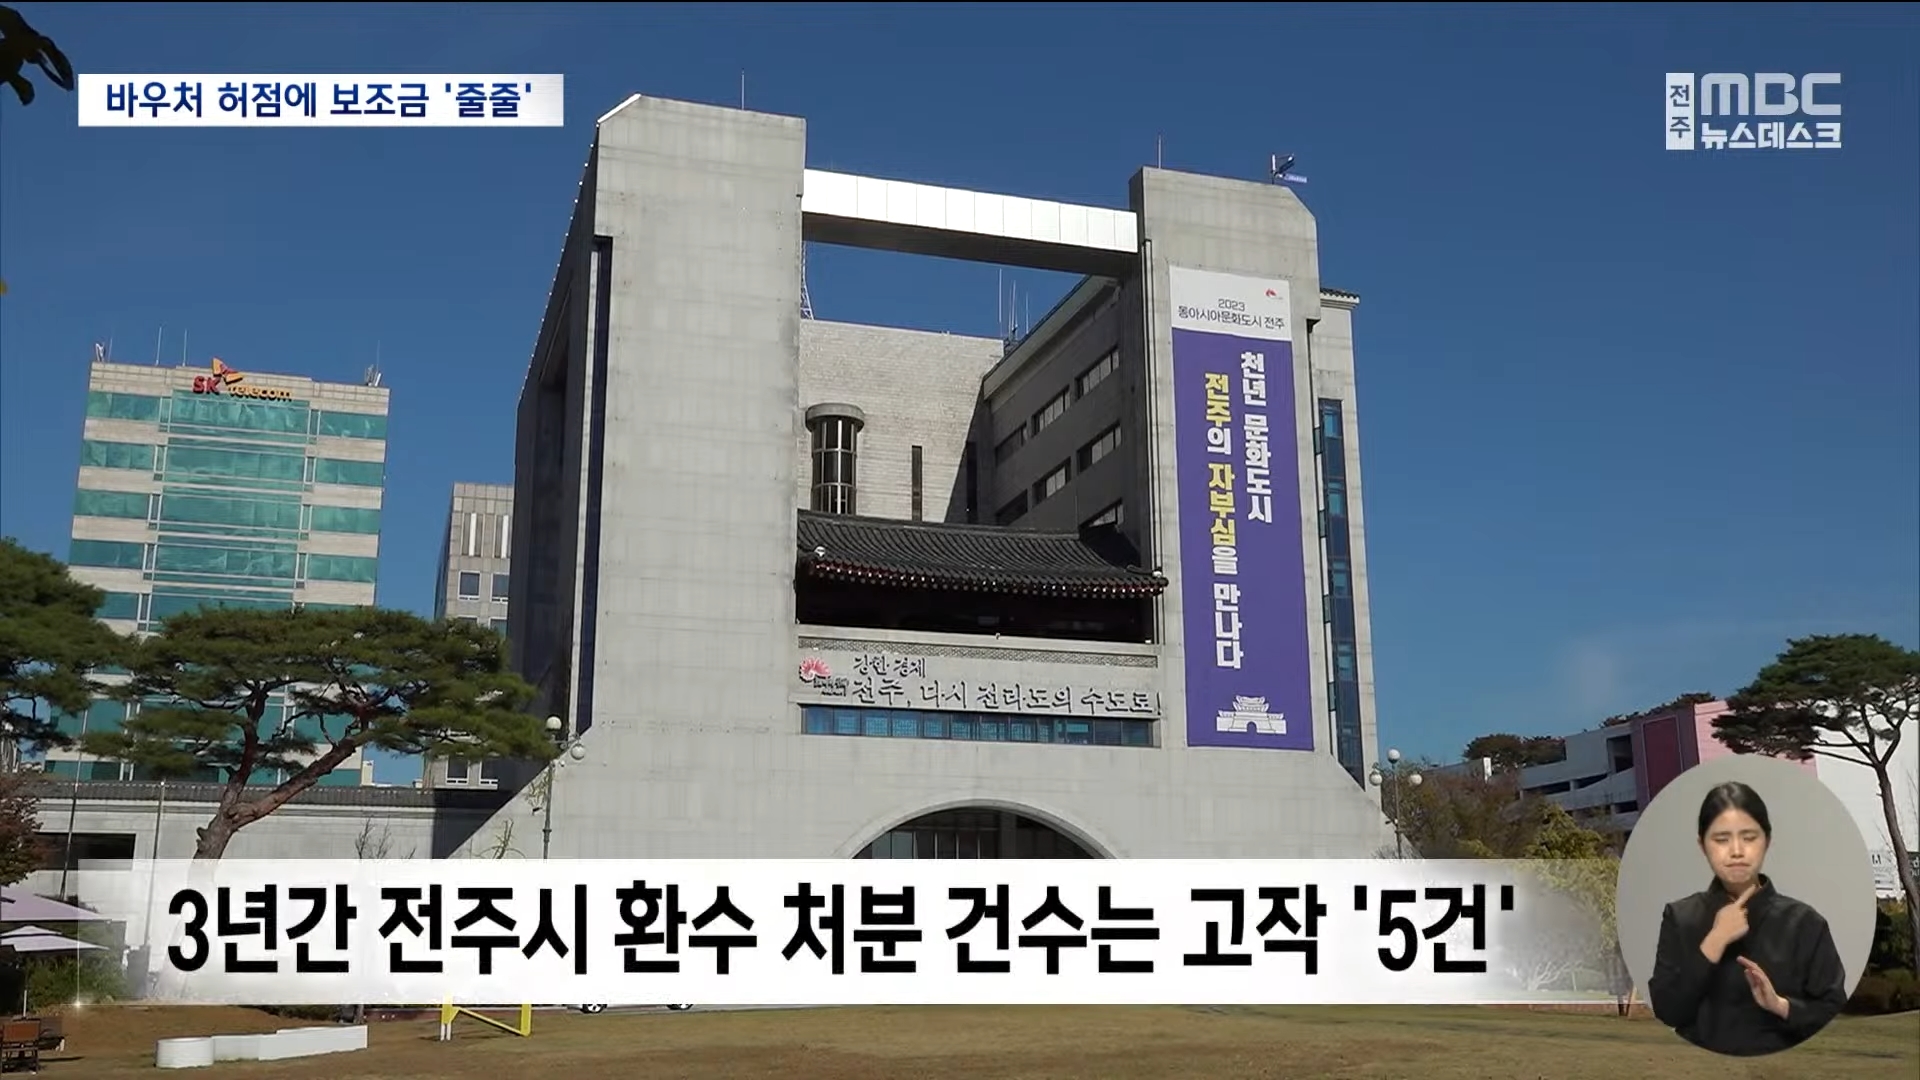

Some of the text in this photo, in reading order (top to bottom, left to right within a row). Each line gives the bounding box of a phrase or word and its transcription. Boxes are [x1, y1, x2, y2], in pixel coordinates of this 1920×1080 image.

[1178, 305, 1285, 330] 동아시아문화도시 전주
[1218, 298, 1246, 312] 2023
[193, 376, 293, 402] SK telecom
[1241, 351, 1273, 524] 천년 문화도시
[1204, 372, 1245, 669] 전주의 자부심을 만나다
[853, 654, 926, 678] 강한 경제
[852, 676, 911, 707] 전주,
[920, 679, 967, 709] 다시
[976, 682, 1072, 714] 전라도의
